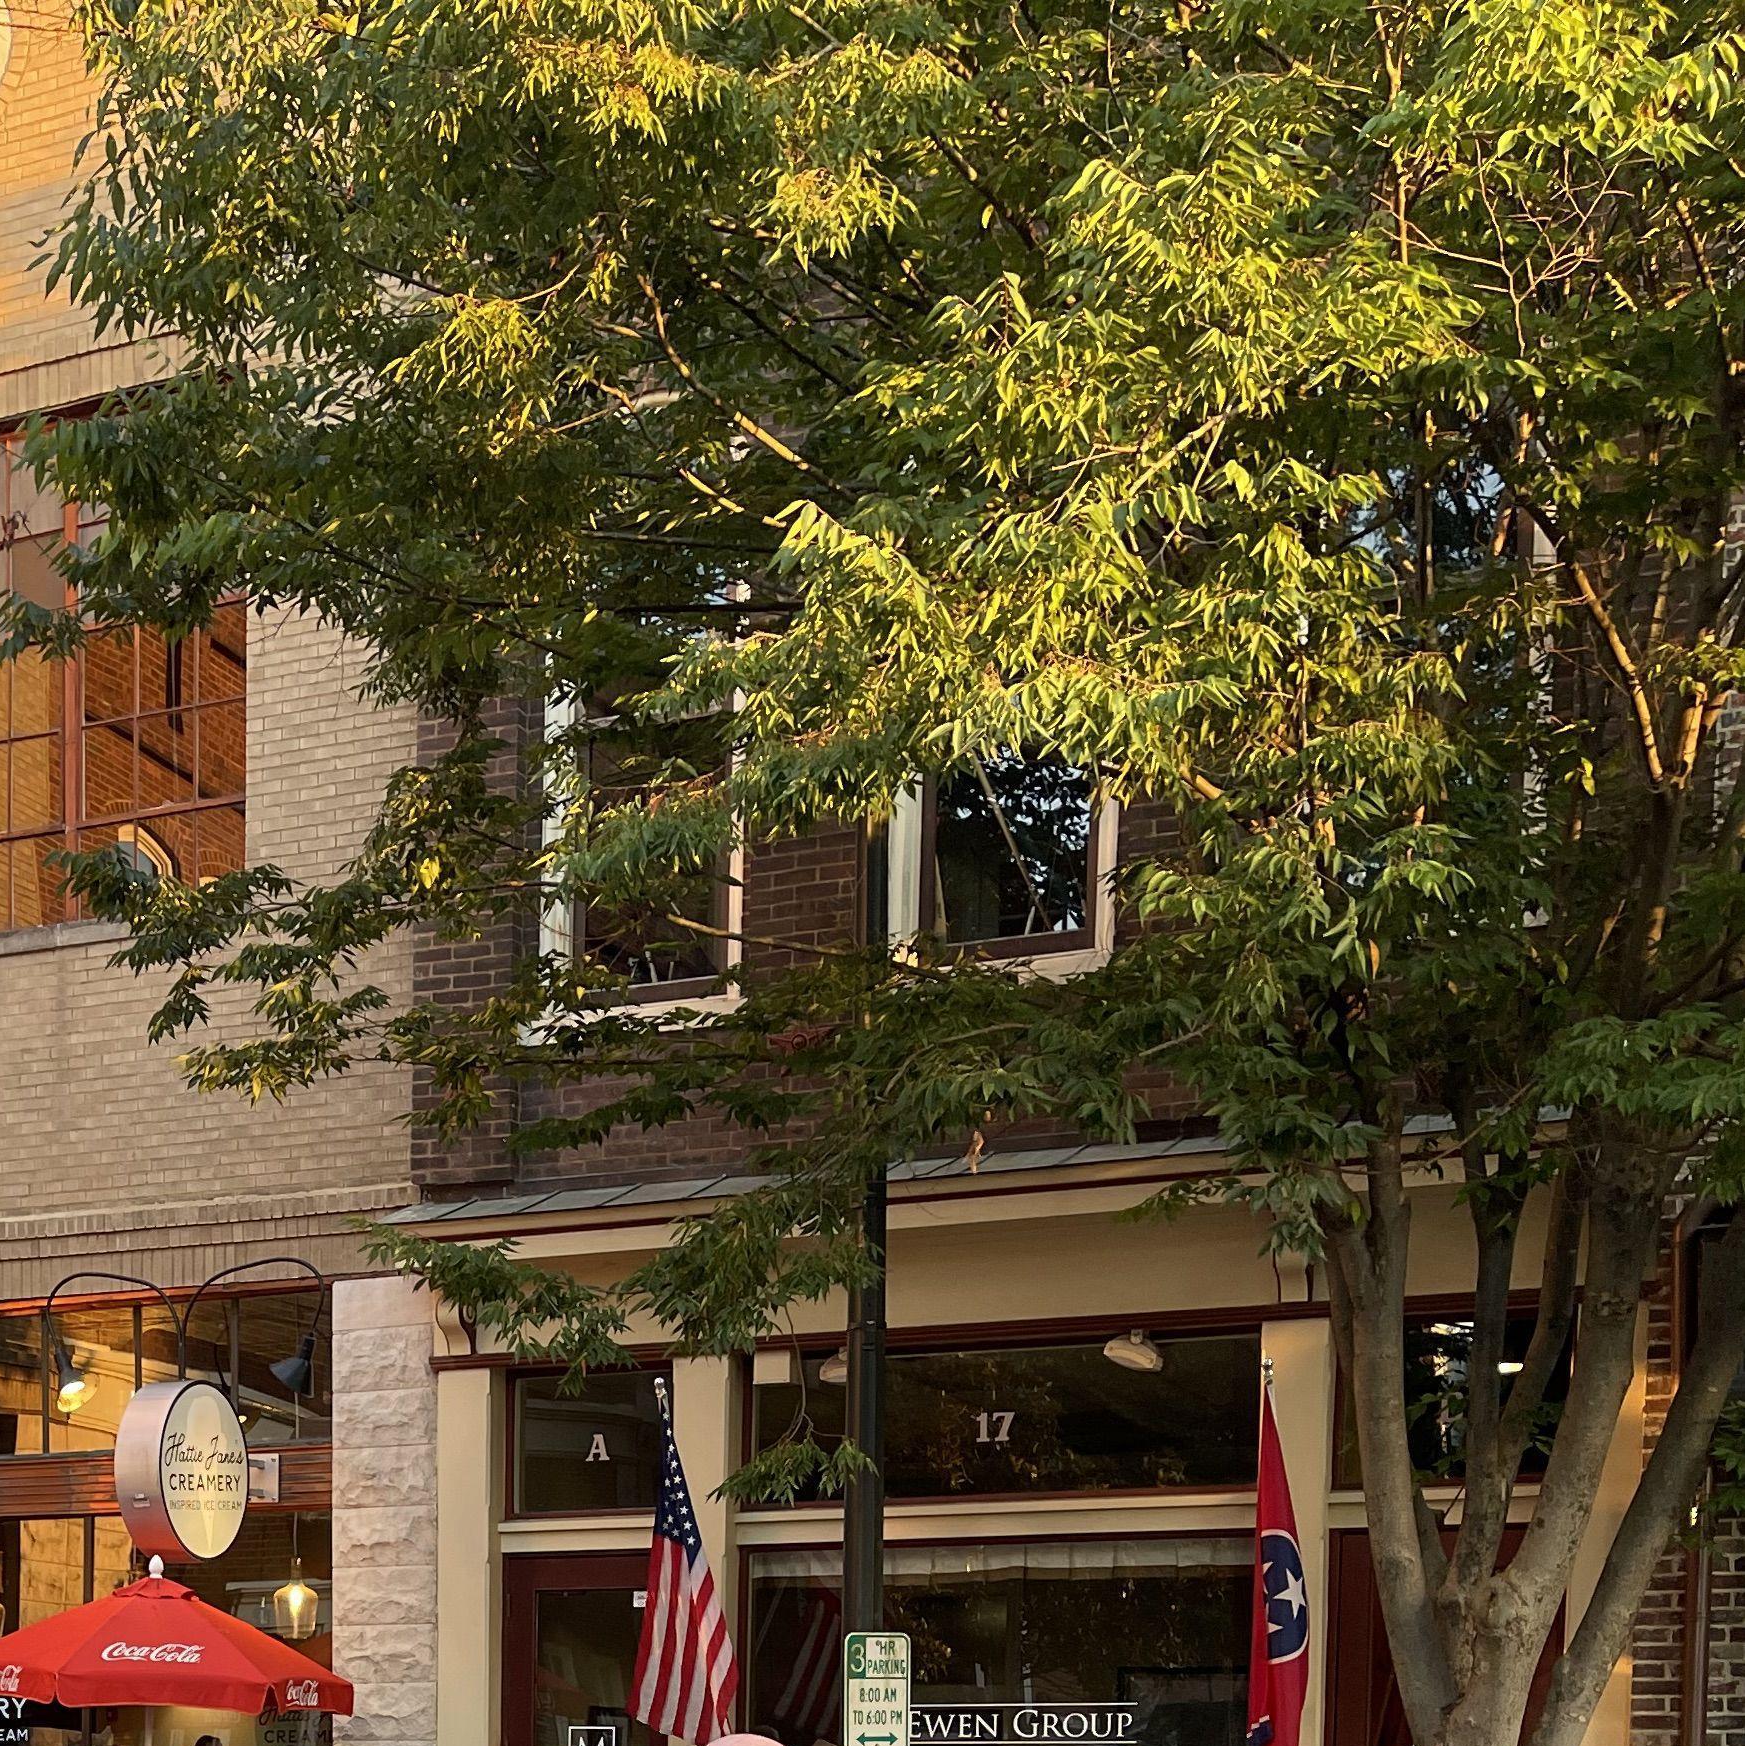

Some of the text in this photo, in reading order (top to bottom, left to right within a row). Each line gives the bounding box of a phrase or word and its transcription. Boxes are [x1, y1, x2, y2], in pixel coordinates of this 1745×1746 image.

[975, 1411, 1015, 1442] 17
[164, 1432, 244, 1470] Hattie Jane's
[585, 1434, 610, 1461] A
[169, 1473, 241, 1492] CREAMERY
[169, 1499, 243, 1511] INSPIRED ICE CREAM
[101, 1641, 205, 1663] Coca-Cola
[850, 1640, 896, 1673] 3 HR
[867, 1659, 906, 1676] PARKING
[859, 1687, 897, 1703] 8:00 AM
[853, 1709, 903, 1725] TO 6:00 PM
[909, 1709, 1134, 1739] EWEN GROUP
